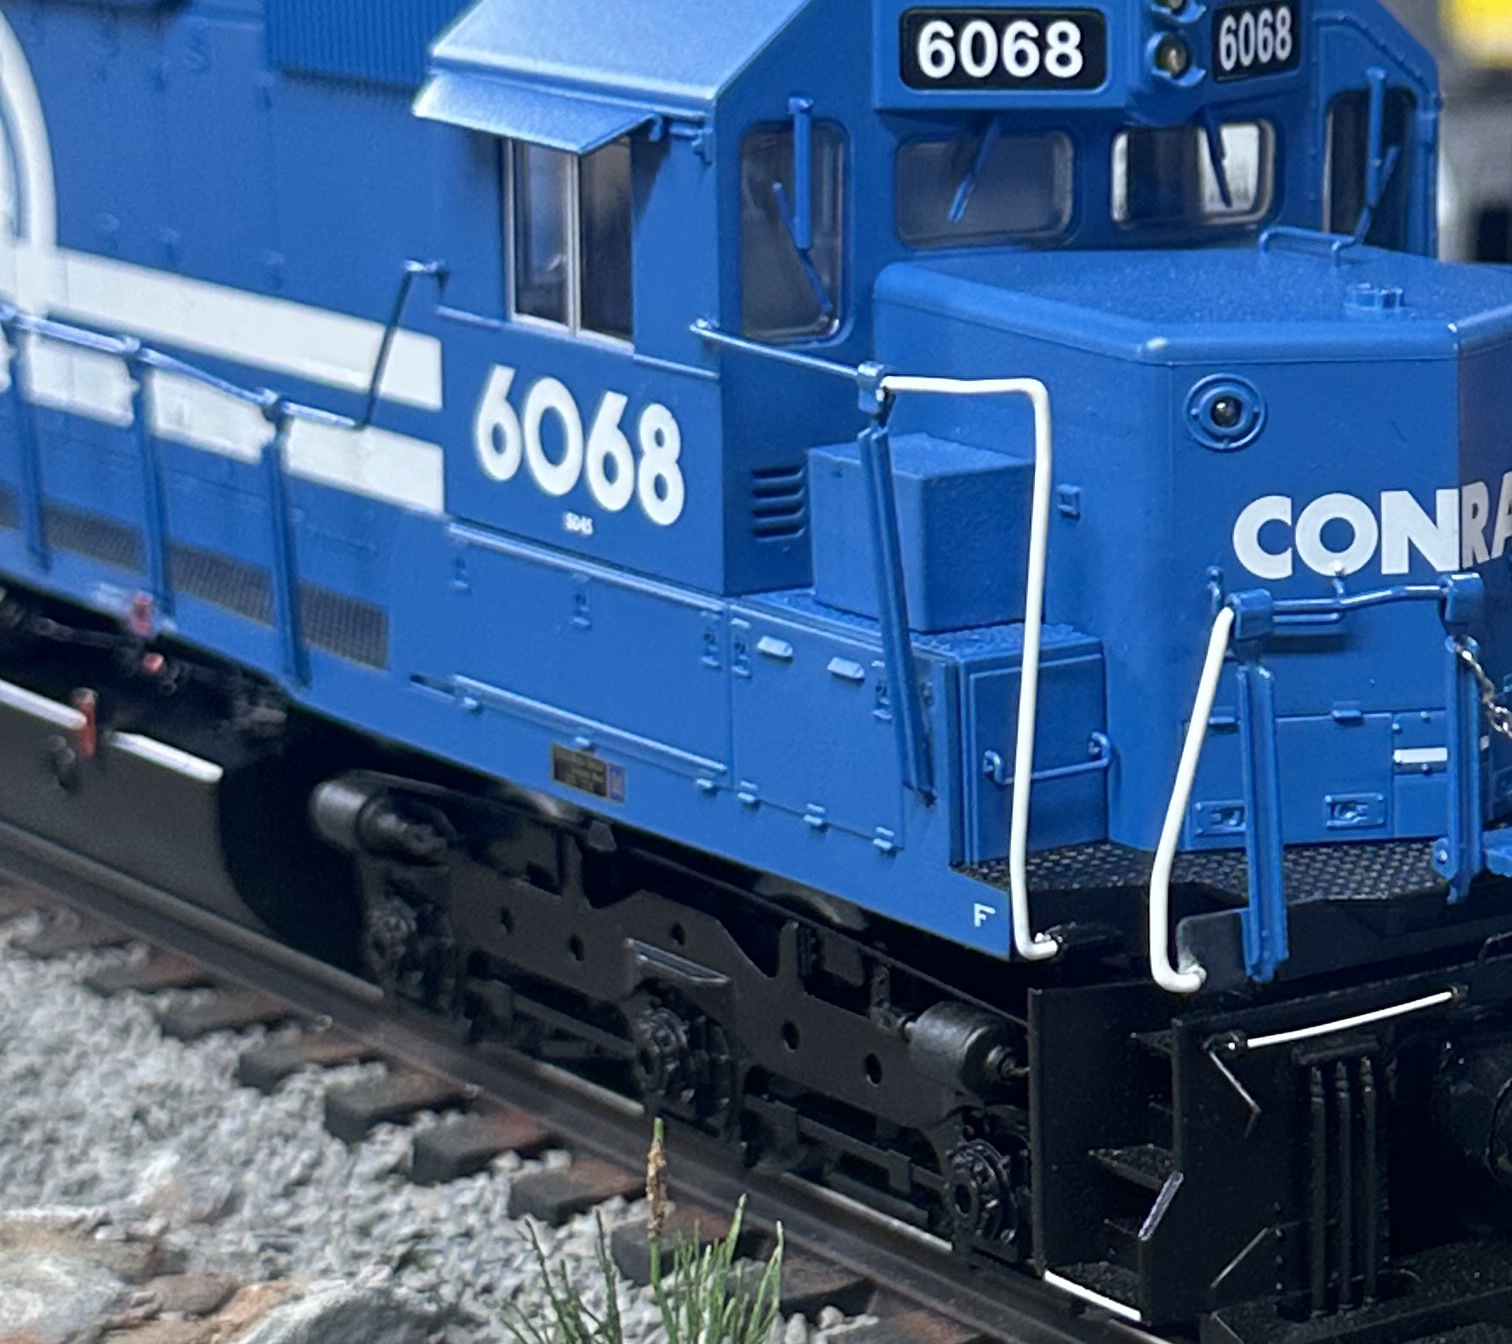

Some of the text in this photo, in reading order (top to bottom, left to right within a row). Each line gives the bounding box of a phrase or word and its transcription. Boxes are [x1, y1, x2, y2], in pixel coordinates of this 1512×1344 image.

[917, 19, 1084, 79] 6068
[1219, 5, 1293, 71] 6068
[475, 363, 685, 526] 6068
[973, 902, 996, 928] F
